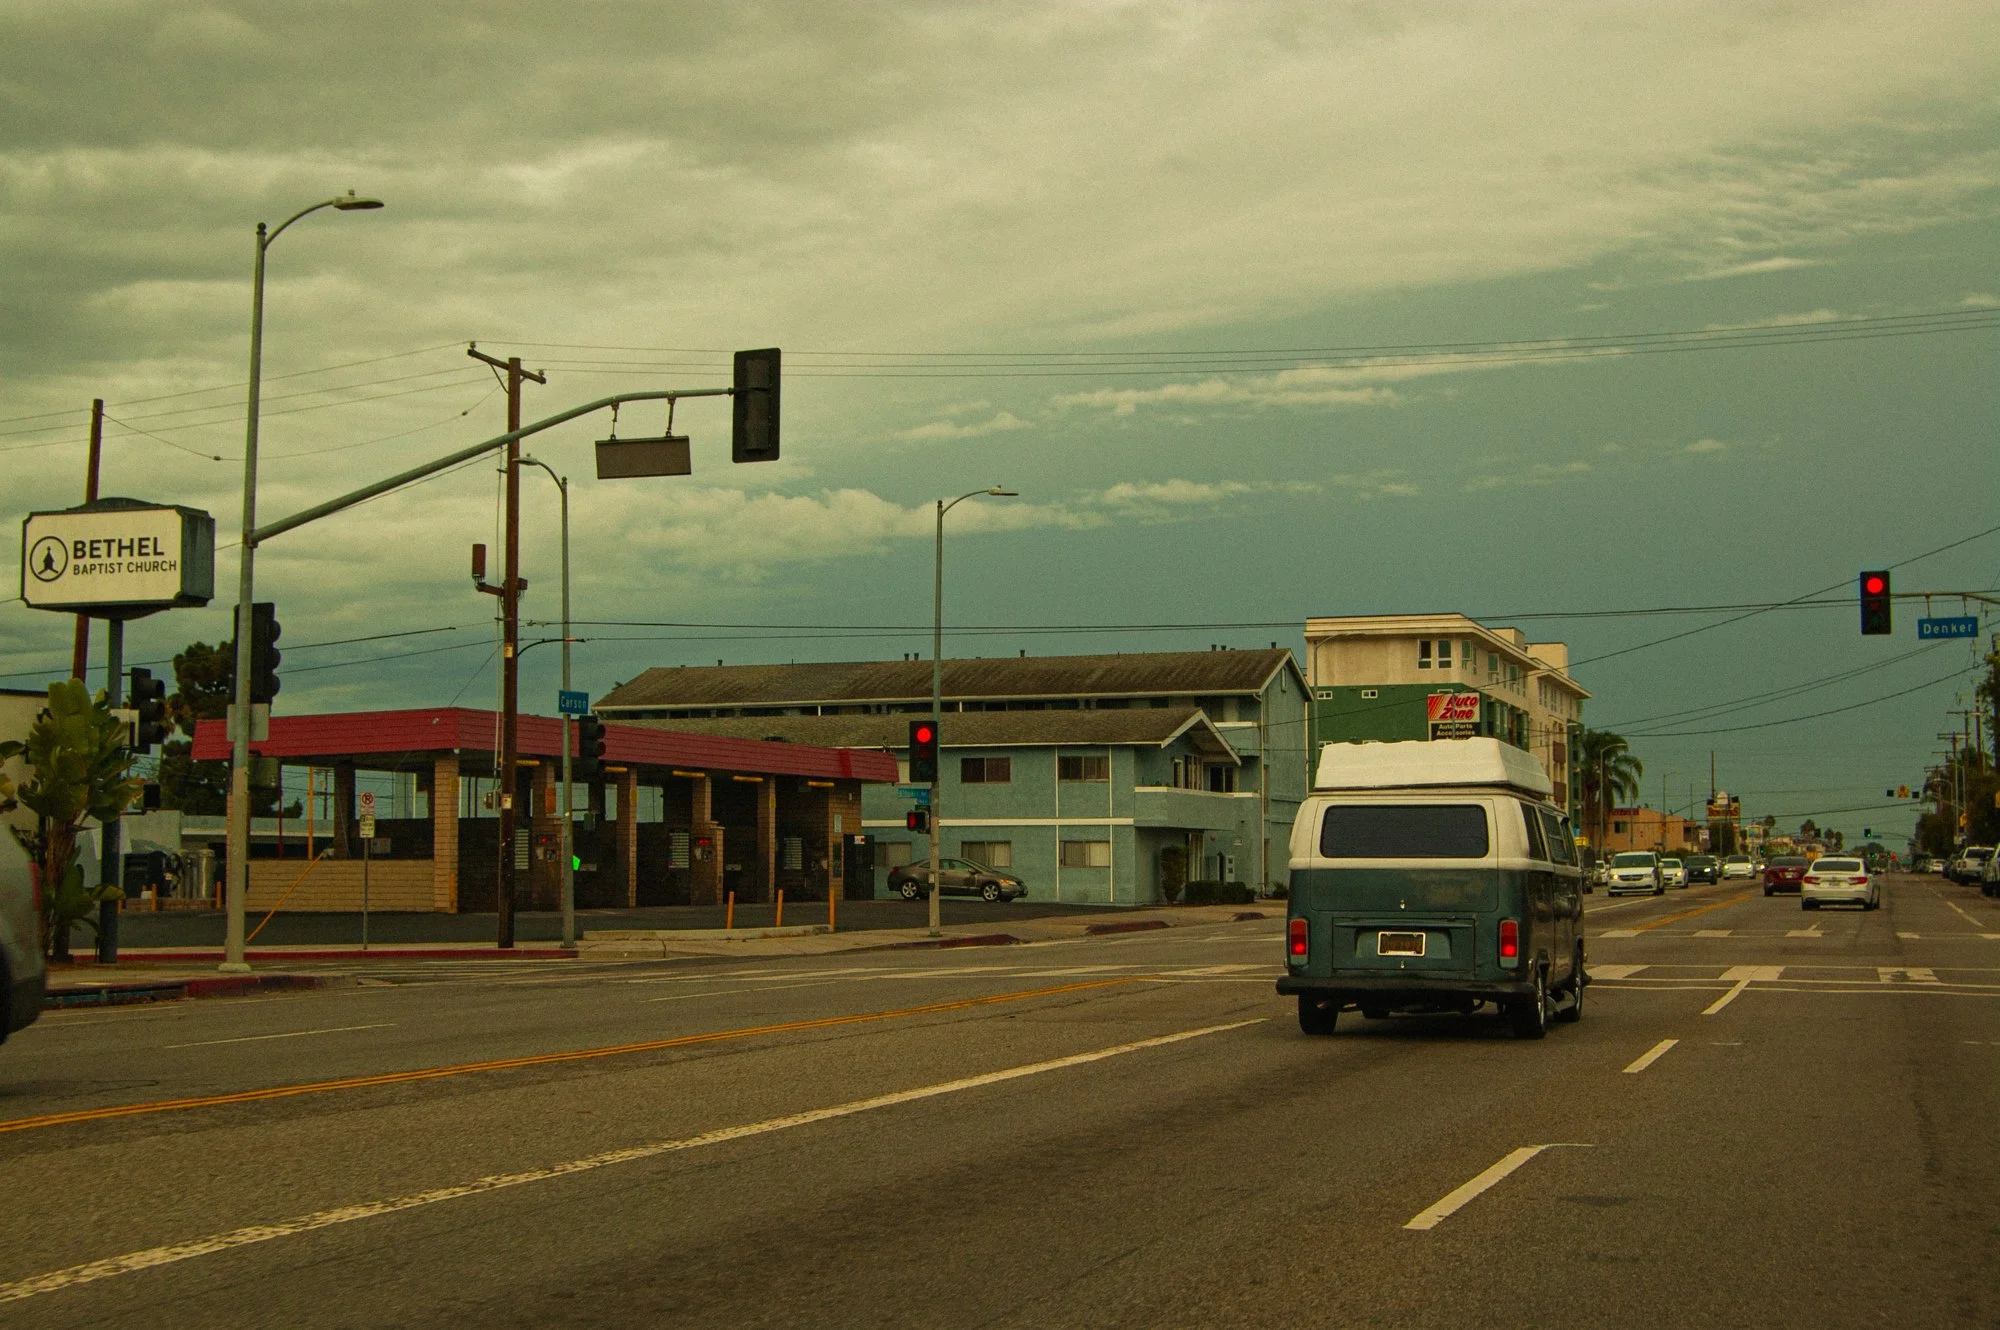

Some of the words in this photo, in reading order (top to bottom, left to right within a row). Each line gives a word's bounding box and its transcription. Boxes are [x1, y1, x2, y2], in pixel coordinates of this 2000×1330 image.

[73, 537, 165, 559] BETHEL
[73, 563, 123, 575] BAPTIST
[127, 560, 177, 573] CHURCH
[1923, 622, 1973, 635] Denker
[561, 696, 587, 709] Carson
